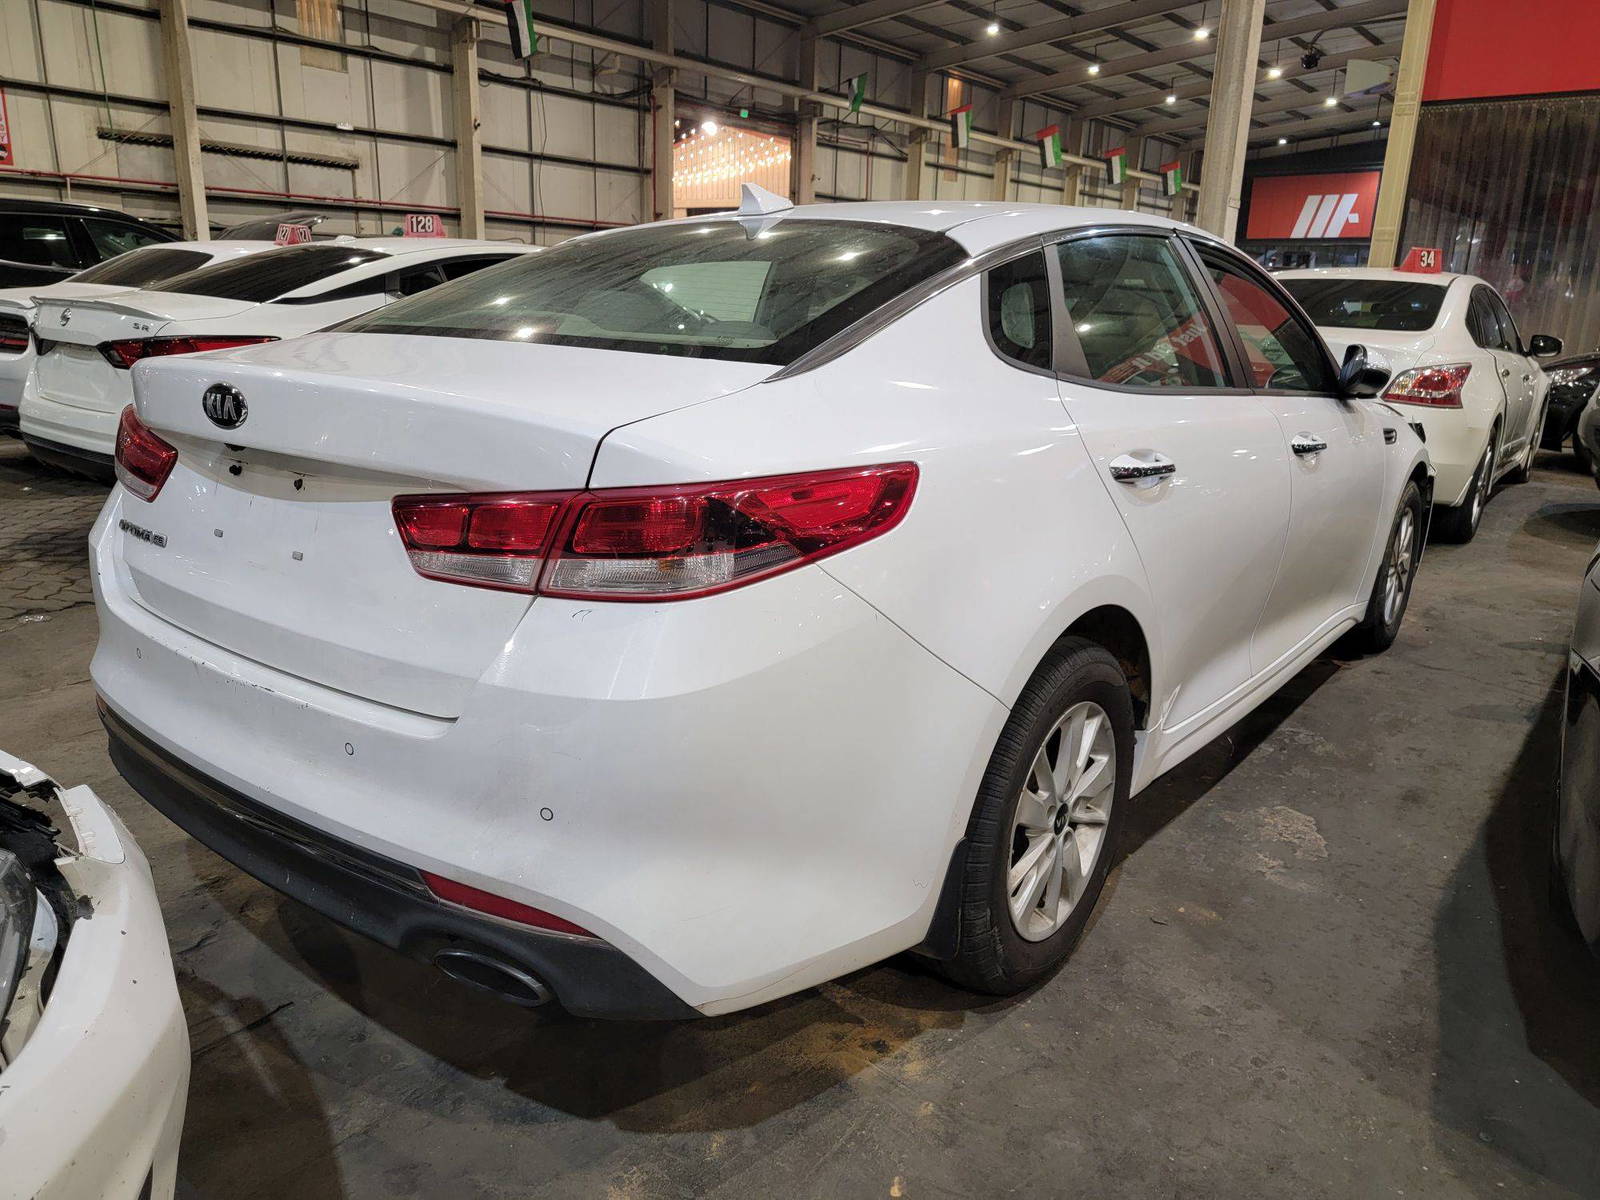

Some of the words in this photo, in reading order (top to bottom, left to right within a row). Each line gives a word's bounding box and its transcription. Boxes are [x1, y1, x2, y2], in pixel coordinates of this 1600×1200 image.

[410, 215, 433, 233] 128
[1420, 250, 1435, 268] 34
[132, 322, 150, 332] SR
[206, 392, 238, 420] KIA
